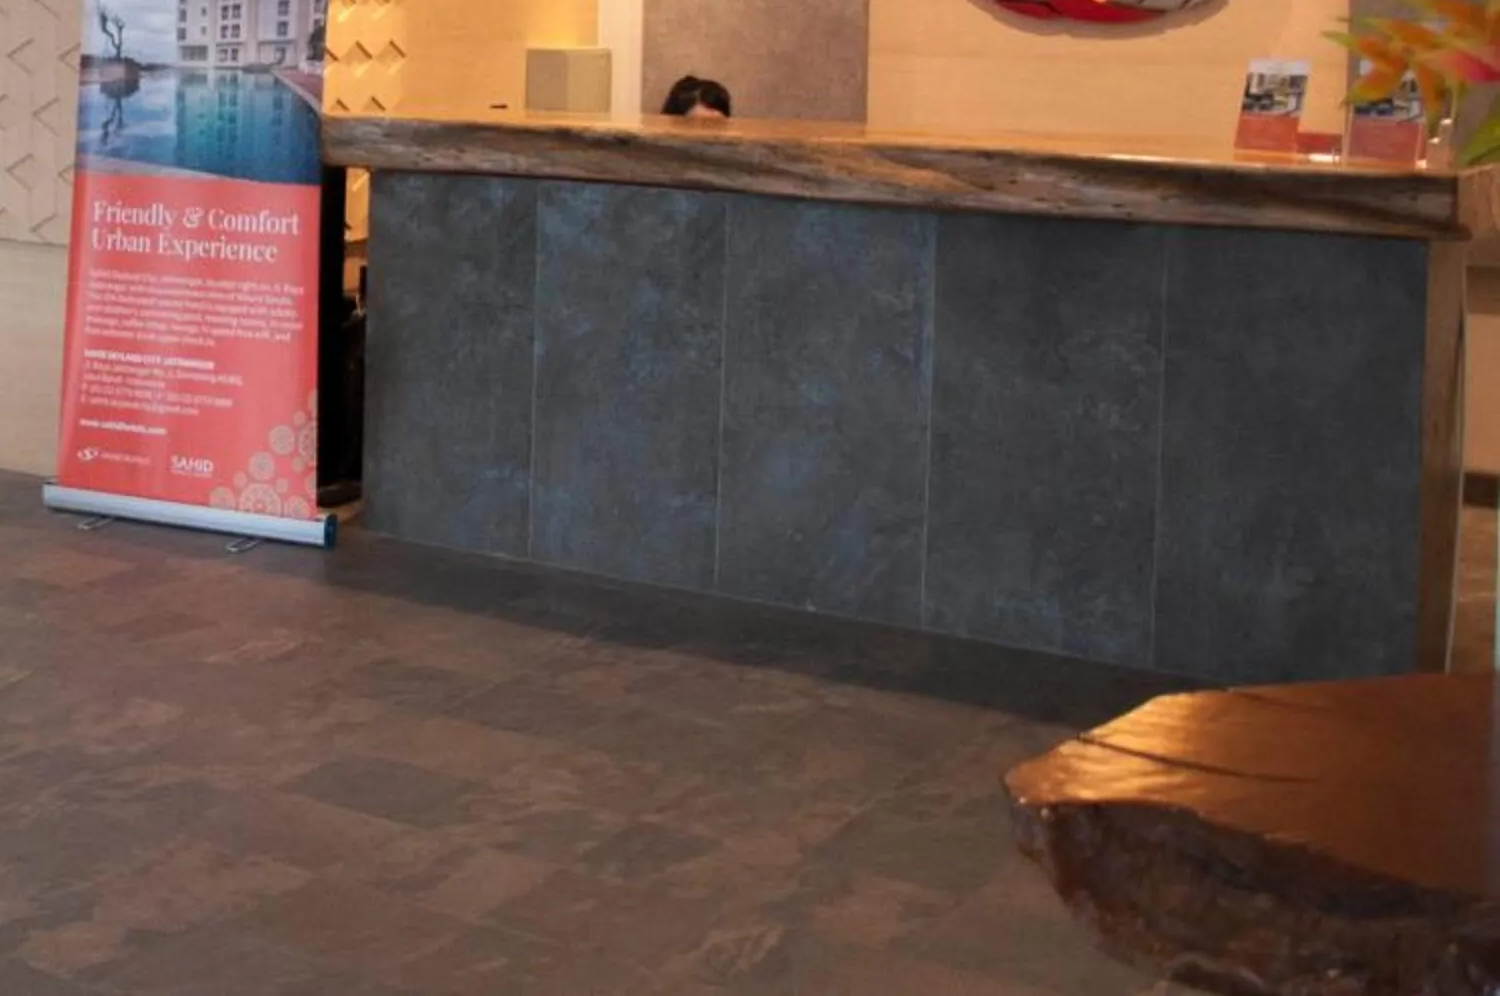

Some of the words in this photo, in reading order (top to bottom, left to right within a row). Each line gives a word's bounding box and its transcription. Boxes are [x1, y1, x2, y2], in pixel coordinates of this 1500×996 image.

[92, 200, 176, 232] Friendly
[182, 207, 205, 229] &
[208, 208, 301, 236] Comfort
[91, 227, 151, 253] Urban
[158, 232, 279, 263] Experience
[171, 454, 215, 473] SAHID
